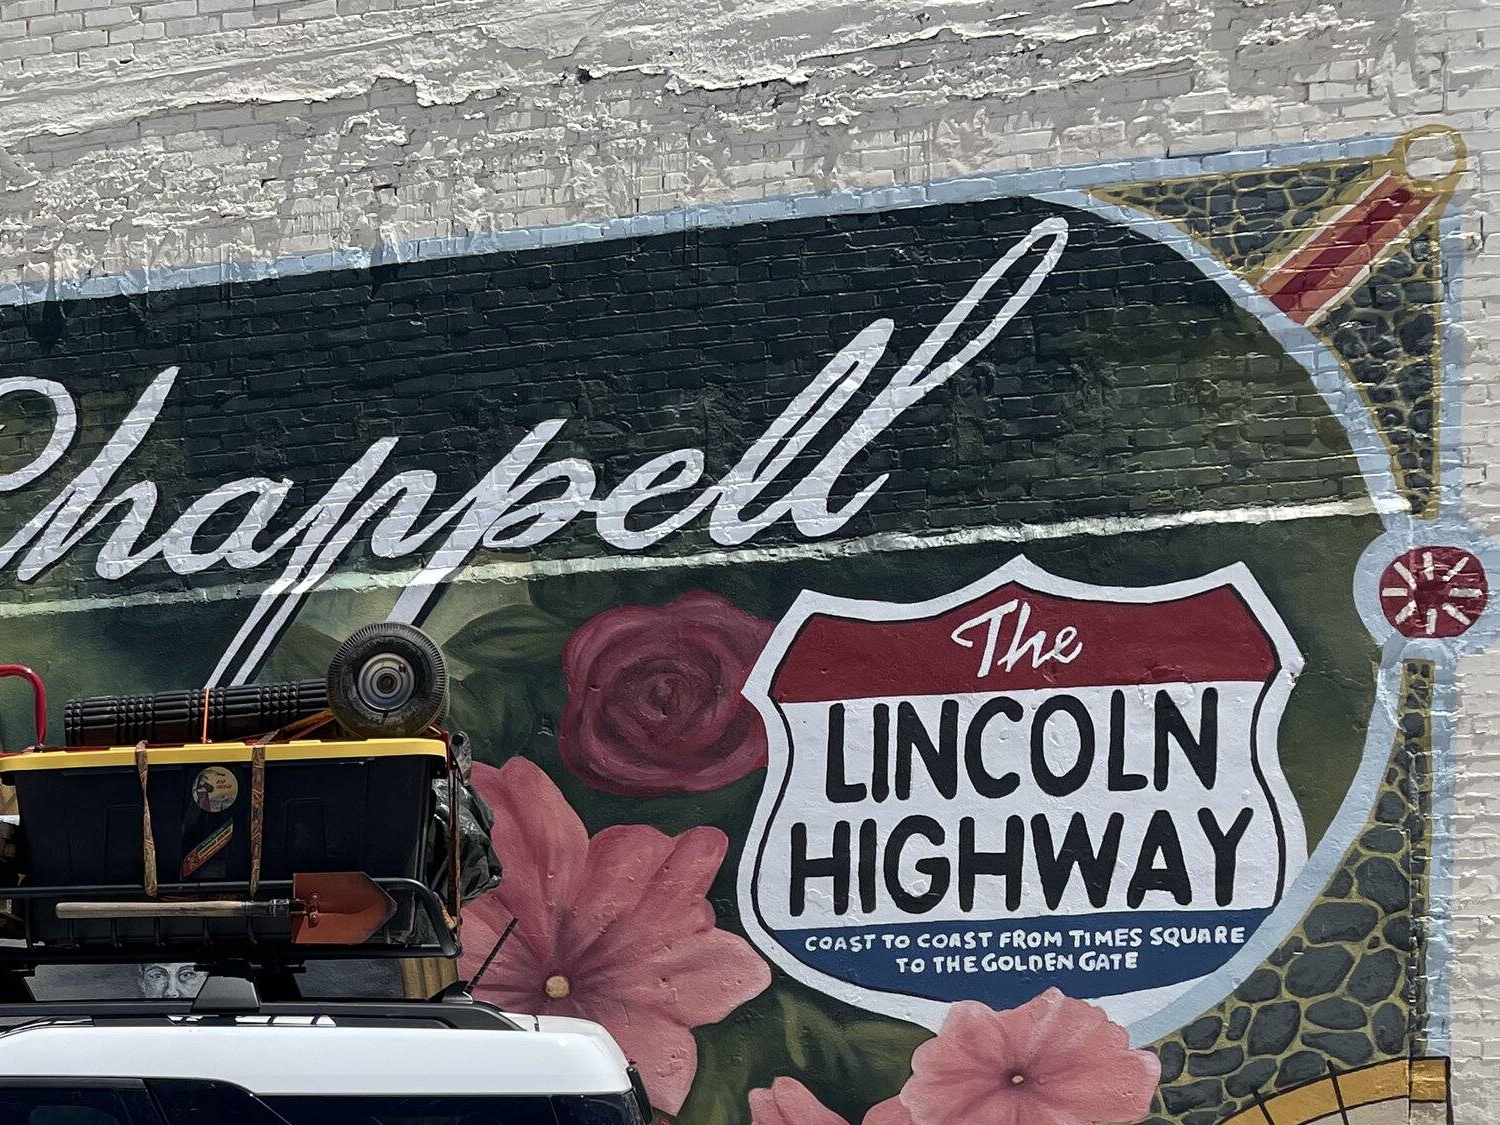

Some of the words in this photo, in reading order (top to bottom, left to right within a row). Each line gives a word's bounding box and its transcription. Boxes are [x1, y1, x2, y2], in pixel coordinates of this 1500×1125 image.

[950, 598, 1083, 679] The
[825, 686, 1219, 804] LINCOLN
[789, 806, 1255, 917] HIGHWAY
[804, 932, 877, 953] COAST
[881, 932, 911, 950] TO
[916, 930, 994, 950] COAST
[998, 928, 1064, 949] FROM
[1068, 926, 1143, 949] TIMES
[1149, 925, 1247, 945] SQUARE
[895, 956, 926, 975] TO
[932, 954, 979, 974] THE
[981, 952, 1075, 974] GOLDEN
[1077, 950, 1139, 972] GATE
